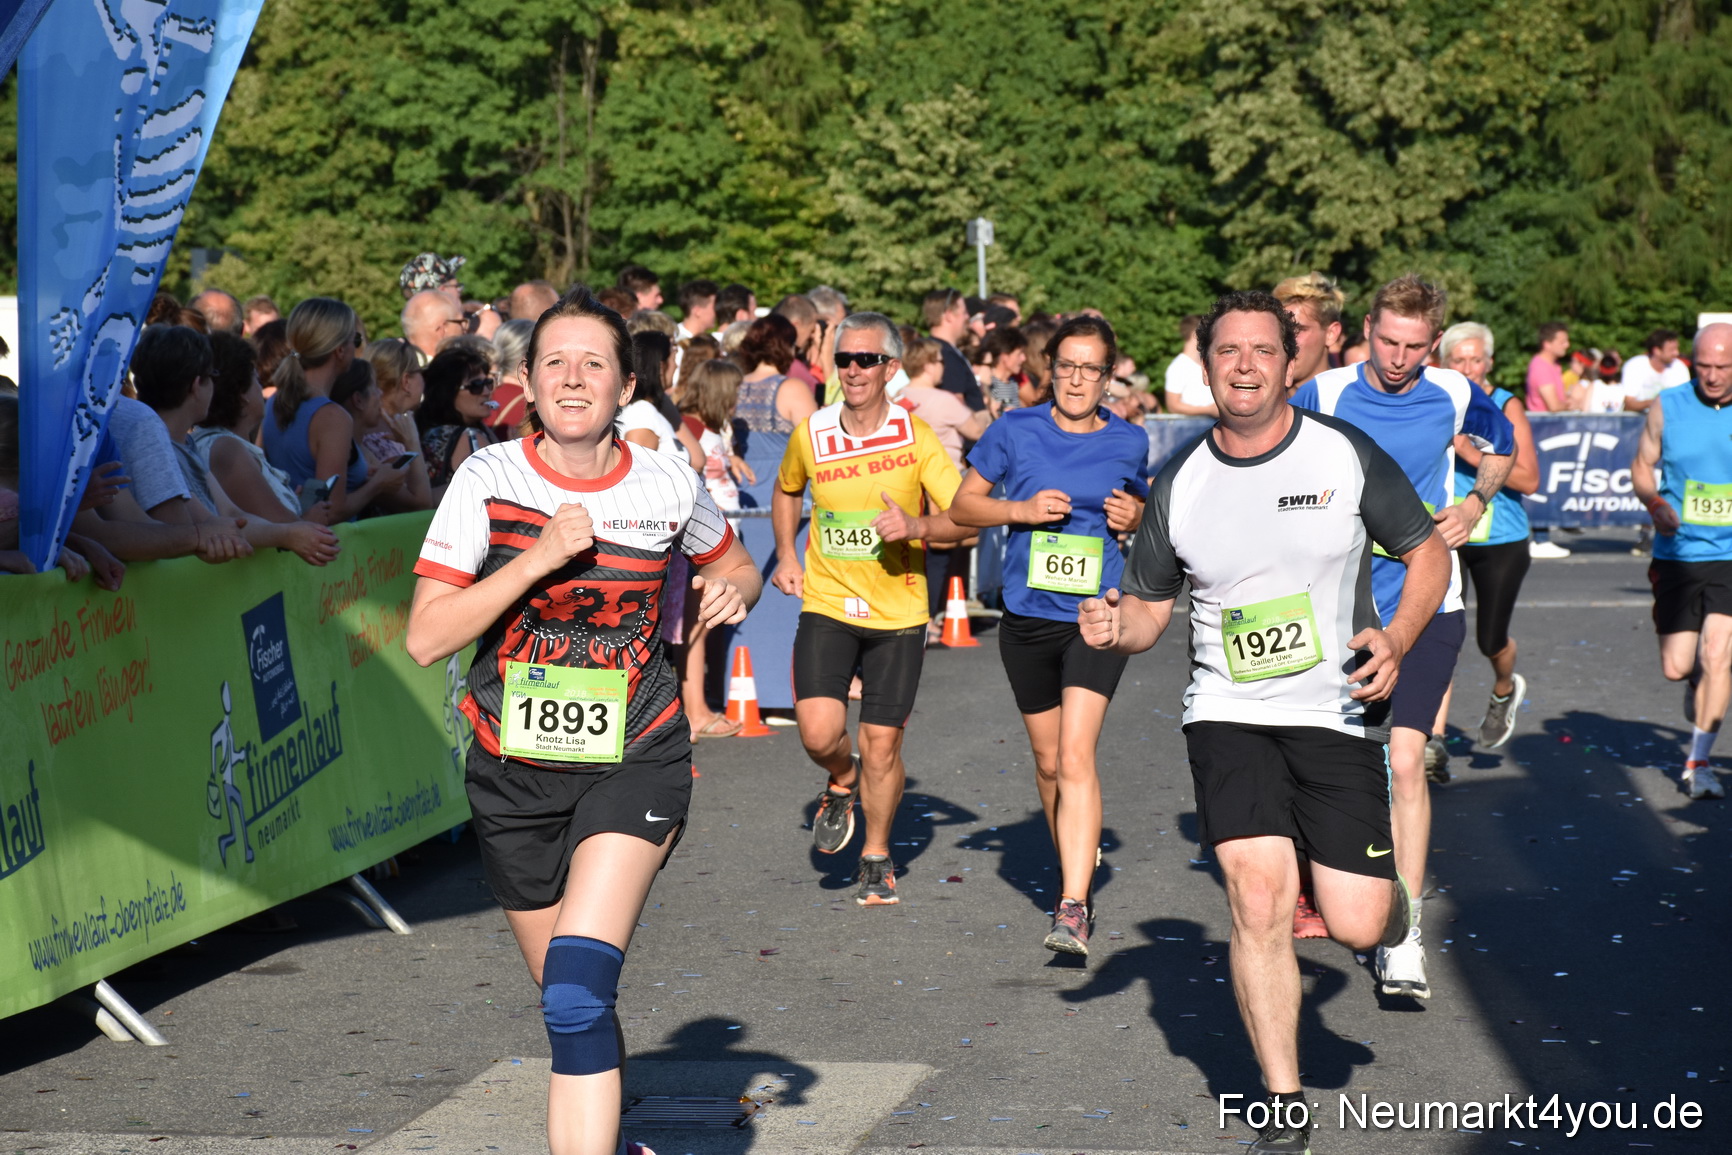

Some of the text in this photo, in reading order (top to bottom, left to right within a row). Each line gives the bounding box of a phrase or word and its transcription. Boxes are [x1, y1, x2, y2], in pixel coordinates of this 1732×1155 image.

[816, 452, 918, 484] MAX BÖGL
[1547, 461, 1634, 494] Fisc
[1278, 494, 1318, 507] swn
[1691, 498, 1732, 514] 1937
[603, 519, 667, 531] NEUMARKT
[824, 528, 873, 546] 1348
[1046, 554, 1086, 577] 661
[319, 548, 404, 624] Gesunde Firmen
[5, 597, 137, 692] Gesunde Firmen
[257, 640, 284, 672] Fischer
[345, 612, 382, 670] laufen
[1232, 622, 1306, 660] 1922
[1250, 654, 1293, 667] Gailler Uwe
[41, 636, 153, 748] laufen länger!
[520, 677, 561, 689] firmenlauf
[518, 697, 608, 736] 1893
[245, 680, 342, 815] firmenlauf
[536, 733, 586, 745] Knotz Lisa
[553, 745, 585, 753] Neumarkt
[258, 796, 302, 850] neumarkt
